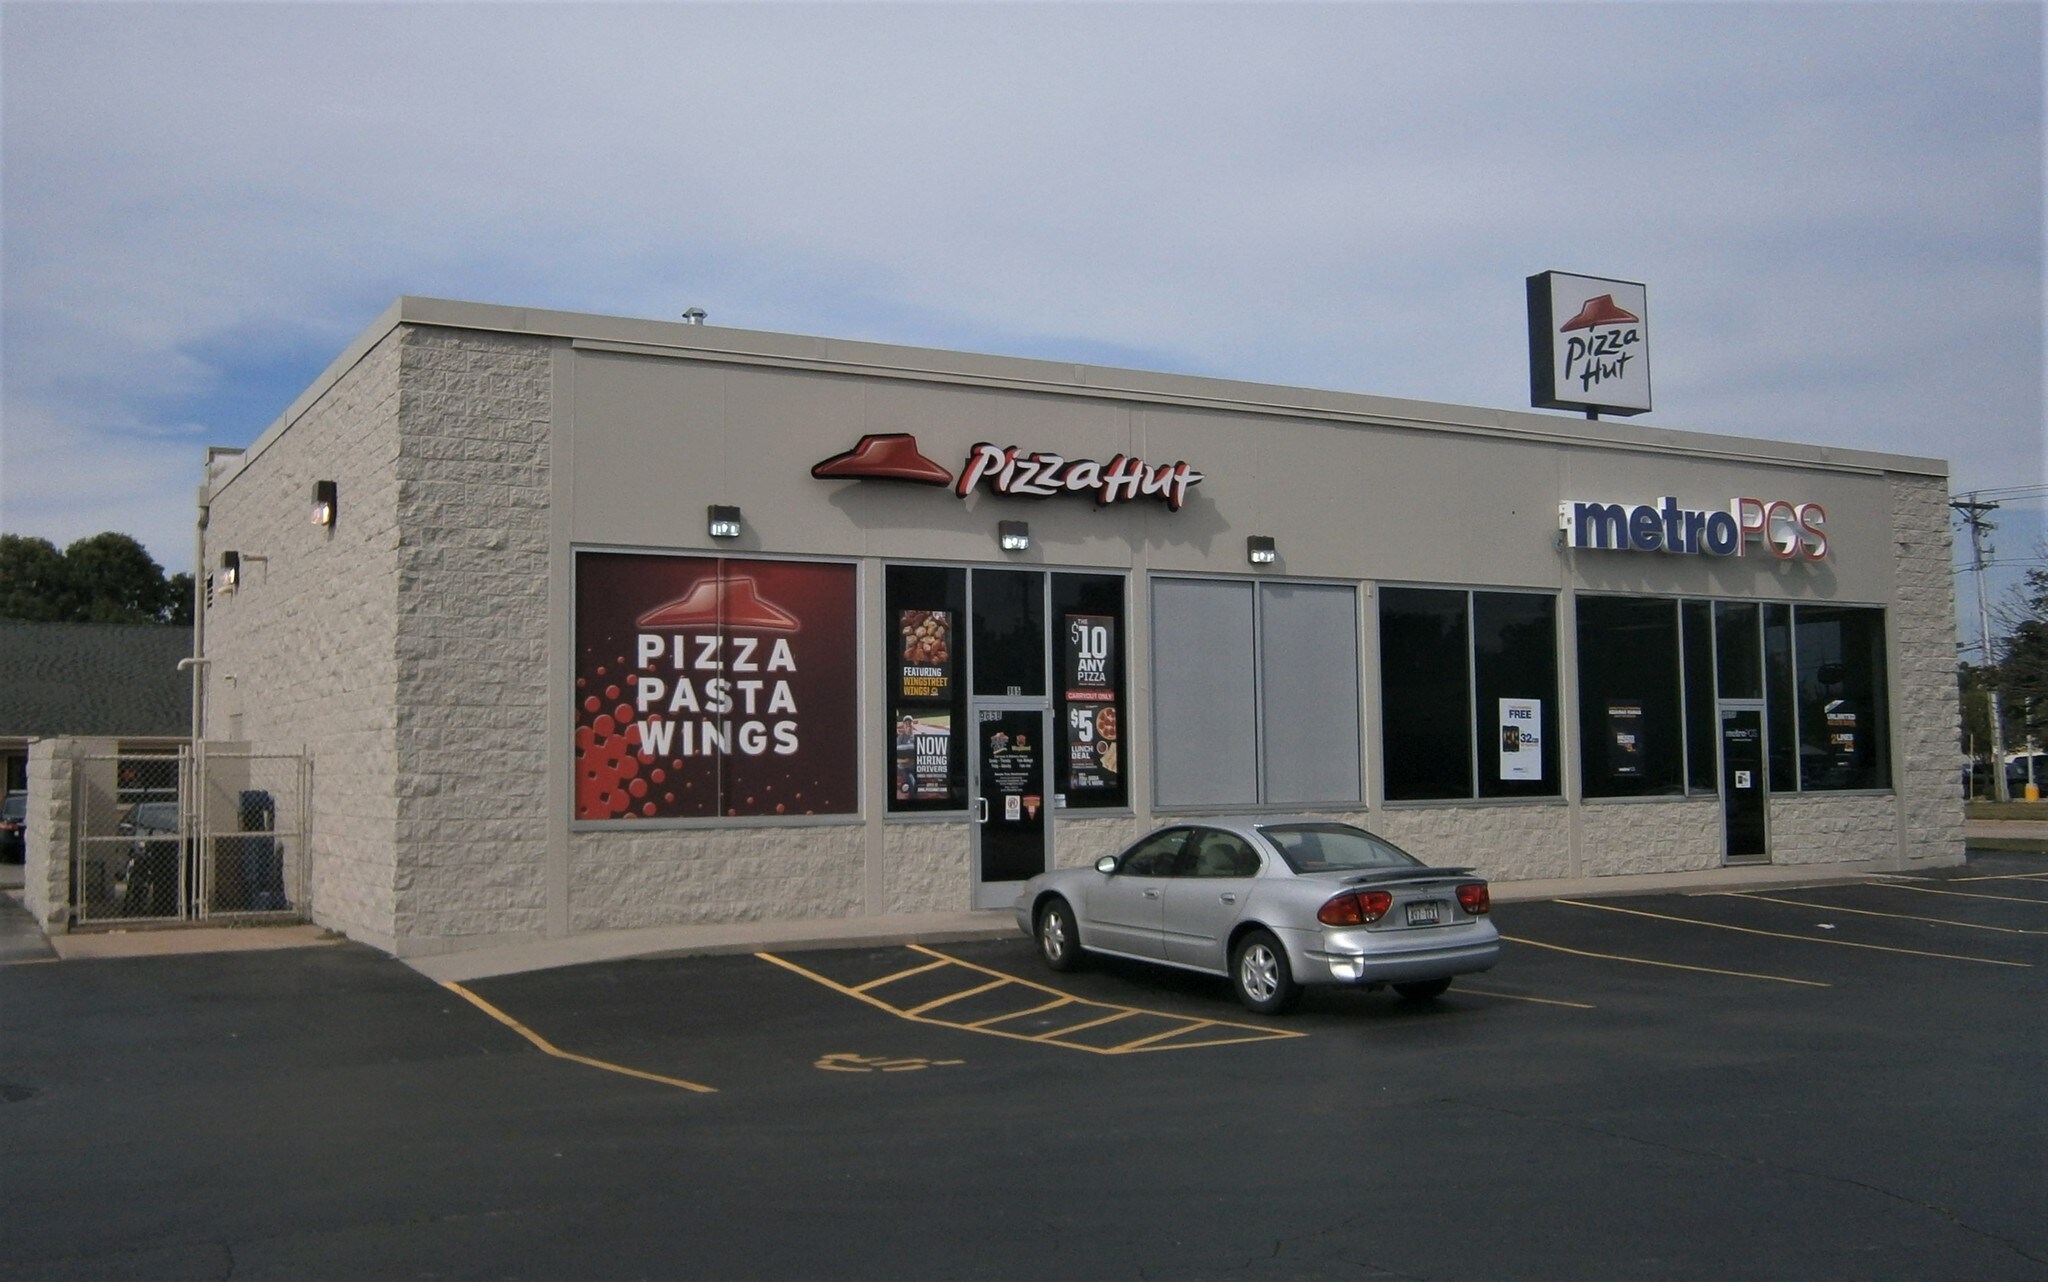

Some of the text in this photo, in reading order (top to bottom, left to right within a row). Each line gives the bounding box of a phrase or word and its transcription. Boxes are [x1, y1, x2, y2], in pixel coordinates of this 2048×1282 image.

[1565, 326, 1640, 380] Pizza
[1579, 352, 1634, 392] Hut
[1097, 453, 1205, 512] Hut
[1566, 496, 1828, 561] metroPCS
[637, 633, 797, 672] PIZZA
[903, 666, 942, 677] FEATURING
[1078, 659, 1106, 672] ANY
[903, 677, 948, 687] WINGSTREET
[1077, 672, 1106, 682] PIZZA
[637, 676, 798, 715] PASTA
[903, 686, 930, 696] WINGS!
[1067, 692, 1112, 700] CARRYOUT ONLY
[1509, 709, 1532, 719] FREE
[1070, 708, 1094, 742] $5
[637, 720, 799, 756] WINGS
[917, 736, 948, 755] NOW
[1071, 745, 1094, 753] LUNCH
[917, 755, 948, 765] HIRING
[1071, 752, 1090, 760] DEAL
[917, 765, 948, 773] DRIVERS
